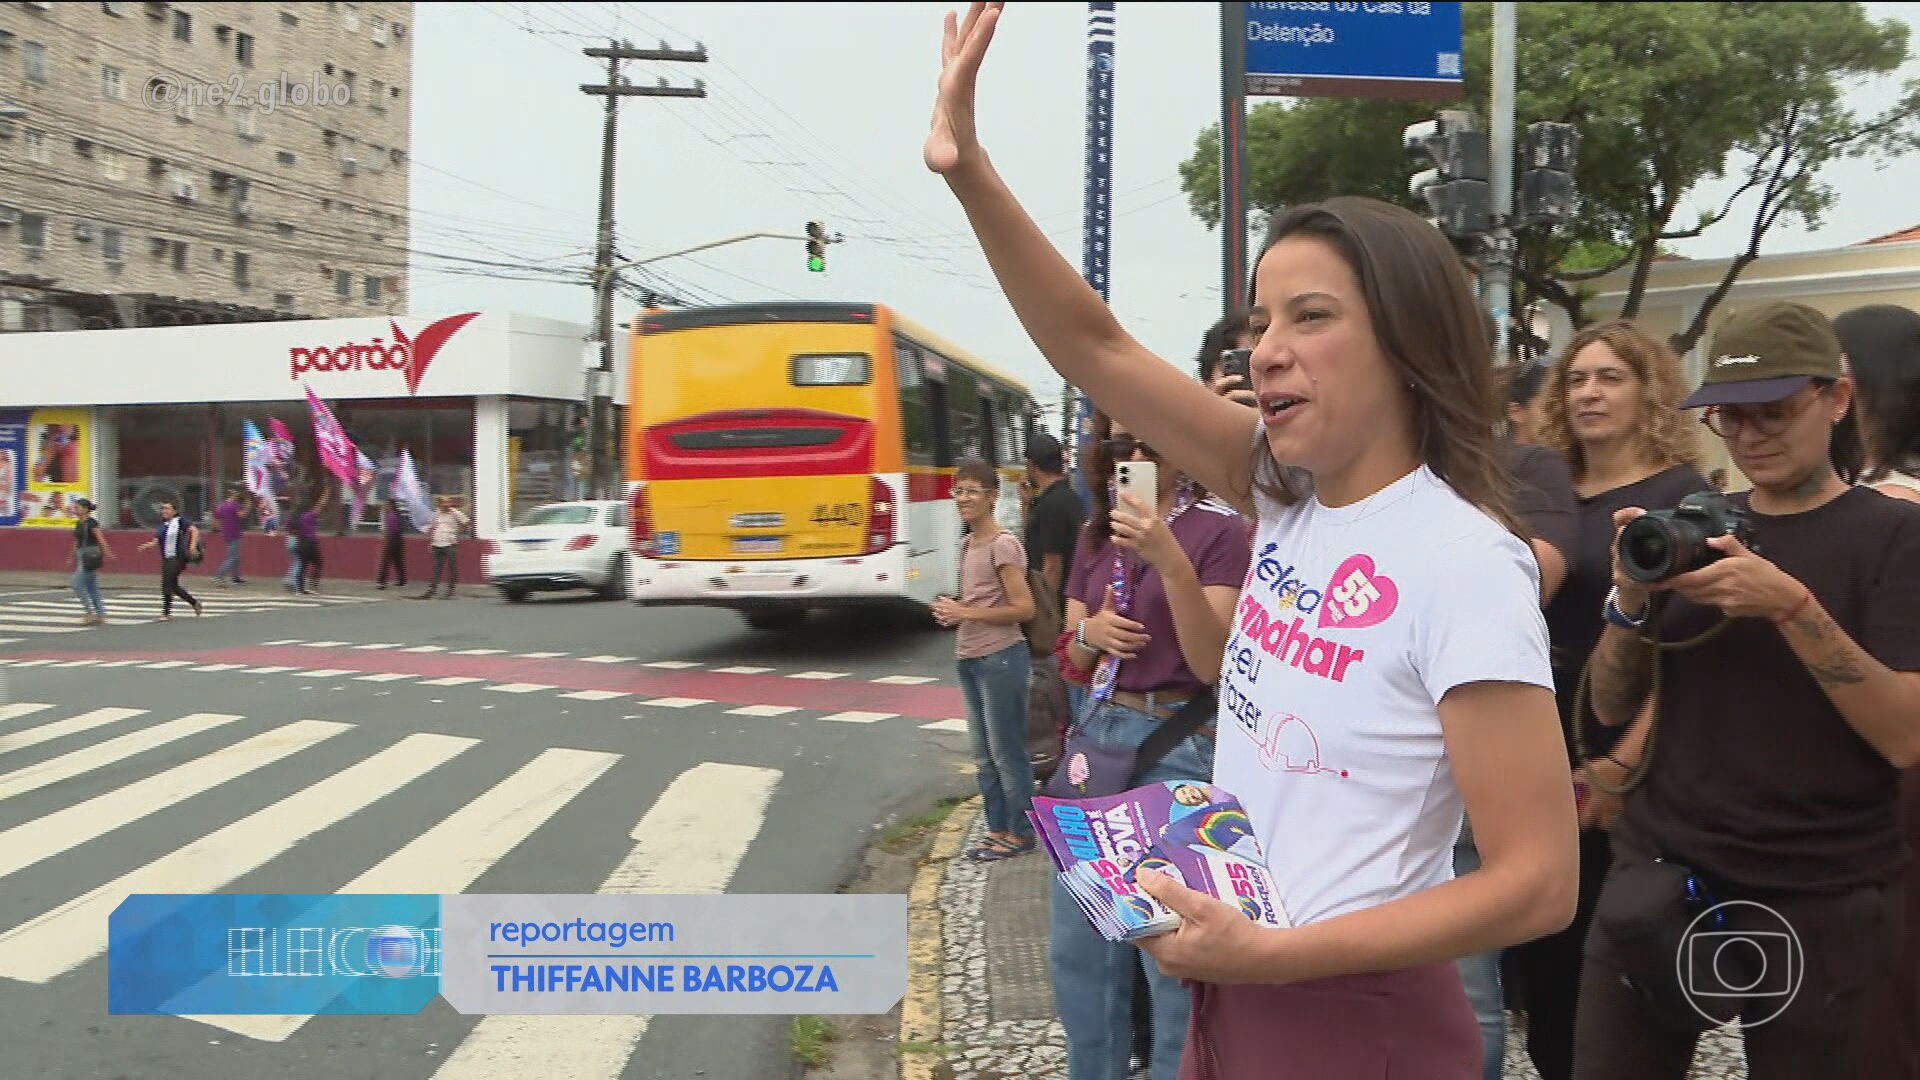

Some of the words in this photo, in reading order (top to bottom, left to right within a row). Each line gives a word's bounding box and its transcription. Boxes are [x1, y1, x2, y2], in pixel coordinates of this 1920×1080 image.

[1362, 2, 1403, 15] Cais
[1407, 2, 1431, 16] da
[1247, 21, 1335, 47] Detenção
[1096, 73, 1108, 163] TELTEX
[289, 337, 410, 380] padrão
[811, 503, 863, 529] 440
[1332, 568, 1382, 617] 55
[1053, 805, 1101, 861] ALHO
[1104, 803, 1142, 857] OVA
[1089, 859, 1137, 894] 55
[1226, 863, 1256, 898] 55
